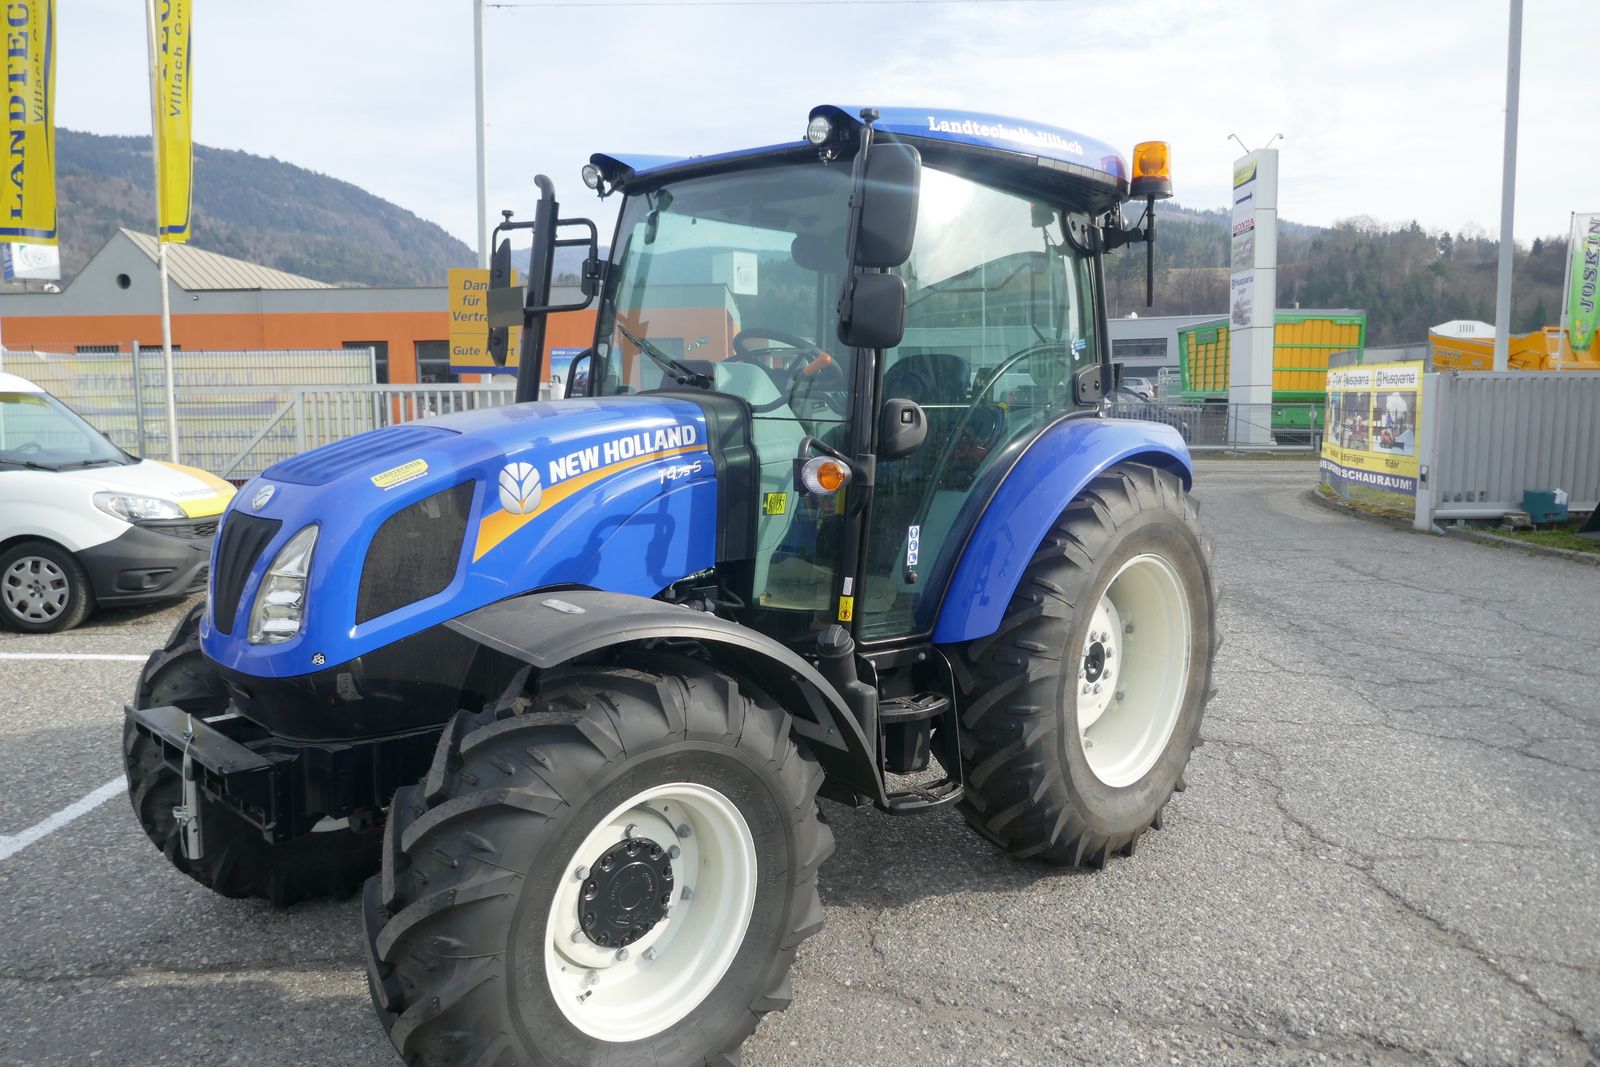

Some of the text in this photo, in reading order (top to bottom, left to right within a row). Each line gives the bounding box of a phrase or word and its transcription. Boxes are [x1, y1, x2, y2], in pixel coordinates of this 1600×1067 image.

[170, 47, 182, 116] Villach
[1580, 217, 1600, 313] JOSKIN
[463, 279, 488, 291] Dan
[462, 295, 480, 306] für
[453, 311, 489, 322] Vertra
[453, 346, 481, 356] Gute
[1382, 372, 1415, 386] Husqvarna
[549, 424, 697, 484] NEW HOLLAND
[1385, 459, 1400, 469] Rider
[1341, 468, 1412, 491] SCHAURAUM!
